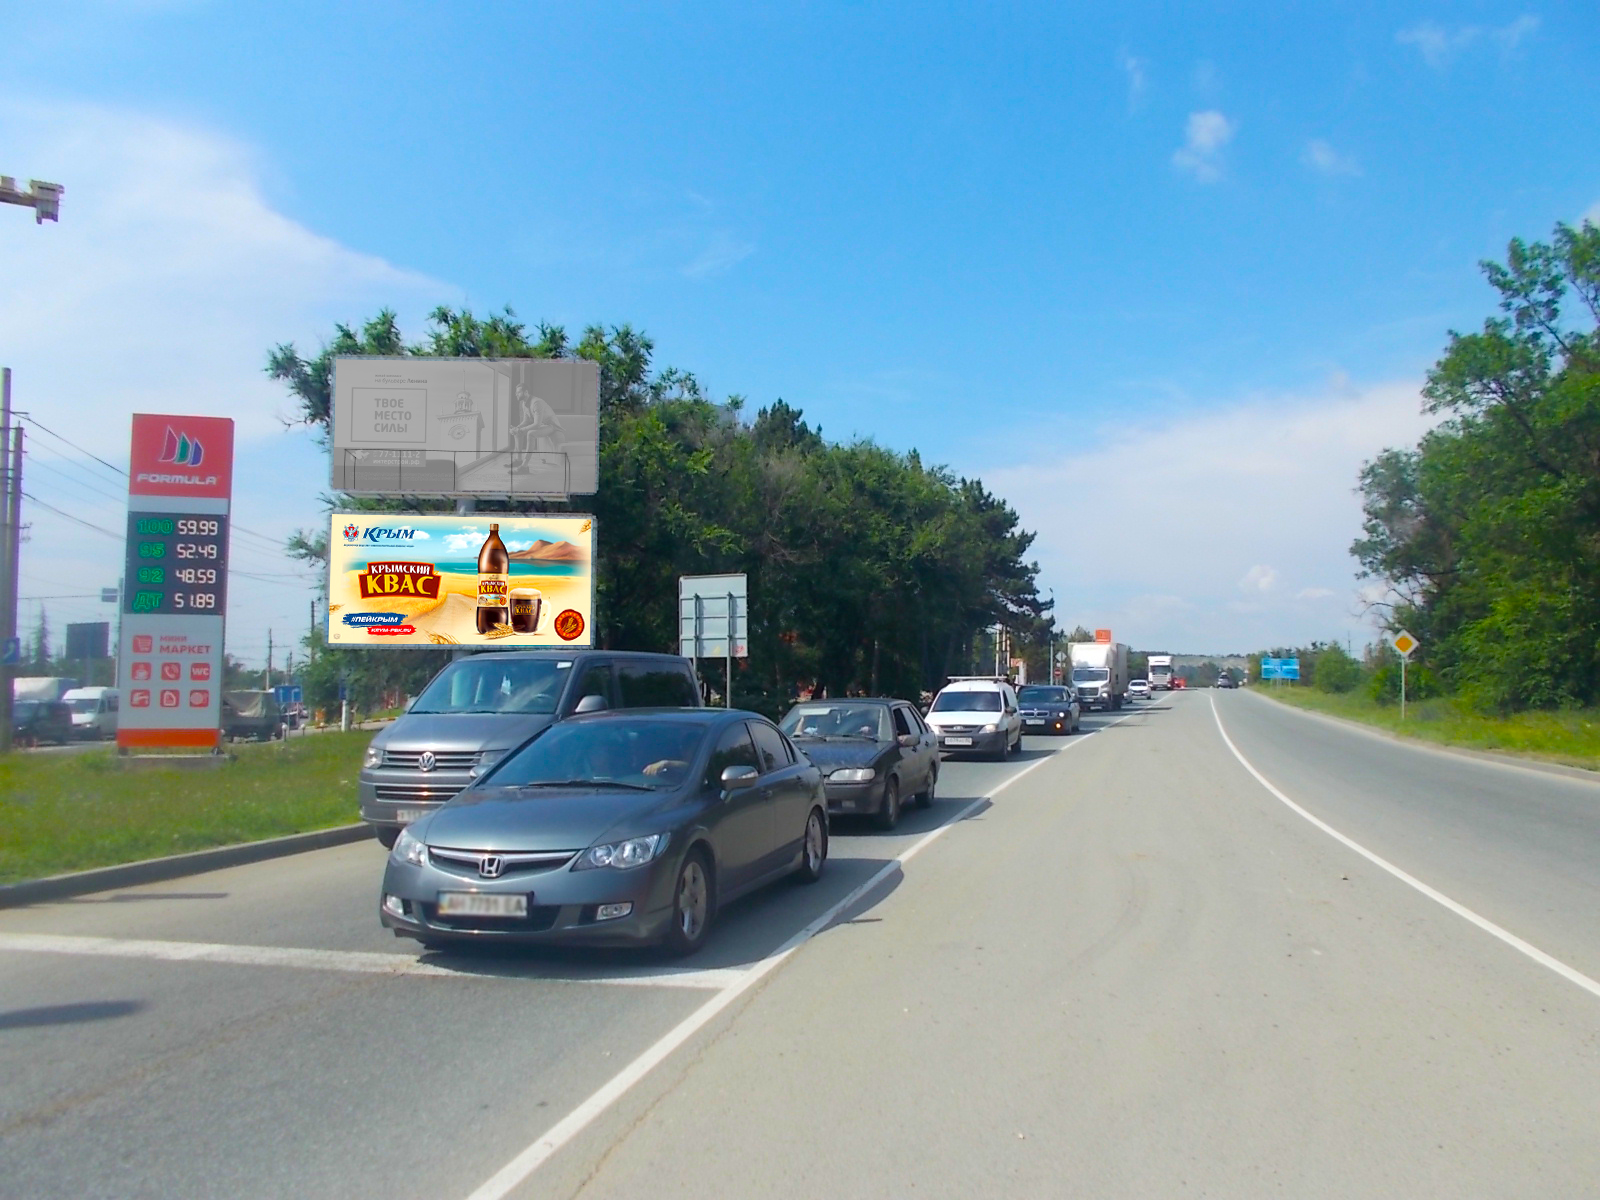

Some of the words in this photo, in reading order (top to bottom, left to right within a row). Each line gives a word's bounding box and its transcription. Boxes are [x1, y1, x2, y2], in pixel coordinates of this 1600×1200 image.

[374, 398, 404, 409] ТВОЕ
[374, 410, 412, 421] МЕСТО
[374, 422, 408, 433] СИЛЫ
[137, 473, 217, 485] FORMULA
[138, 519, 173, 534] 100
[178, 520, 218, 535] 59.99
[139, 544, 165, 557] 95
[177, 544, 217, 559] 52.49
[371, 564, 431, 575] КРЫМСКИЙ
[139, 569, 164, 583] 92
[176, 569, 216, 584] 48.59
[366, 574, 434, 595] КВАС
[480, 585, 506, 594] КВАС
[135, 593, 162, 609] ДТ
[351, 614, 399, 623] #ПЕЙКРЫМ
[160, 645, 211, 654] МАРКЕТ
[192, 667, 209, 676] WC
